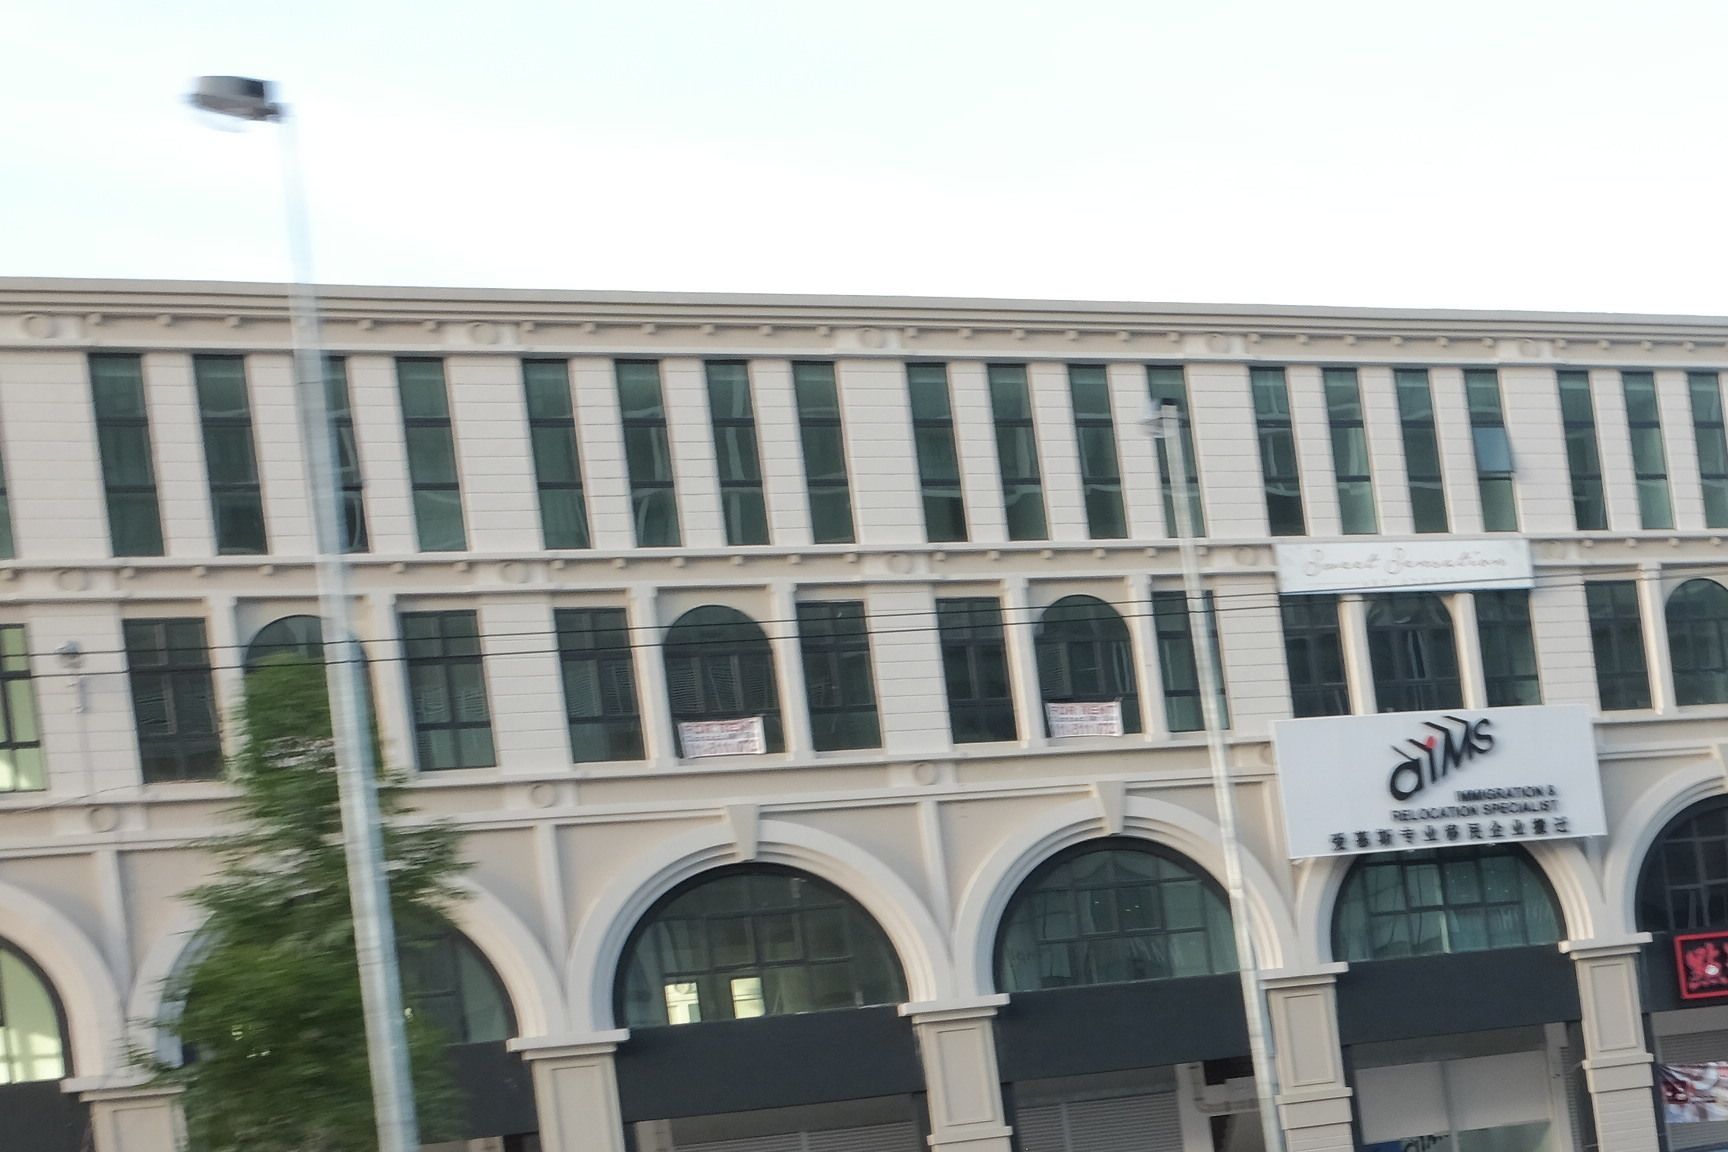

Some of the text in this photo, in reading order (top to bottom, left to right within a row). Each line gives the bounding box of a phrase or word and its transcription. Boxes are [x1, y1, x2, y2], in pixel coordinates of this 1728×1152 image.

[1456, 786, 1543, 802] IMMIGRATION
[1391, 799, 1559, 822] RELOCATION SPECIALIST
